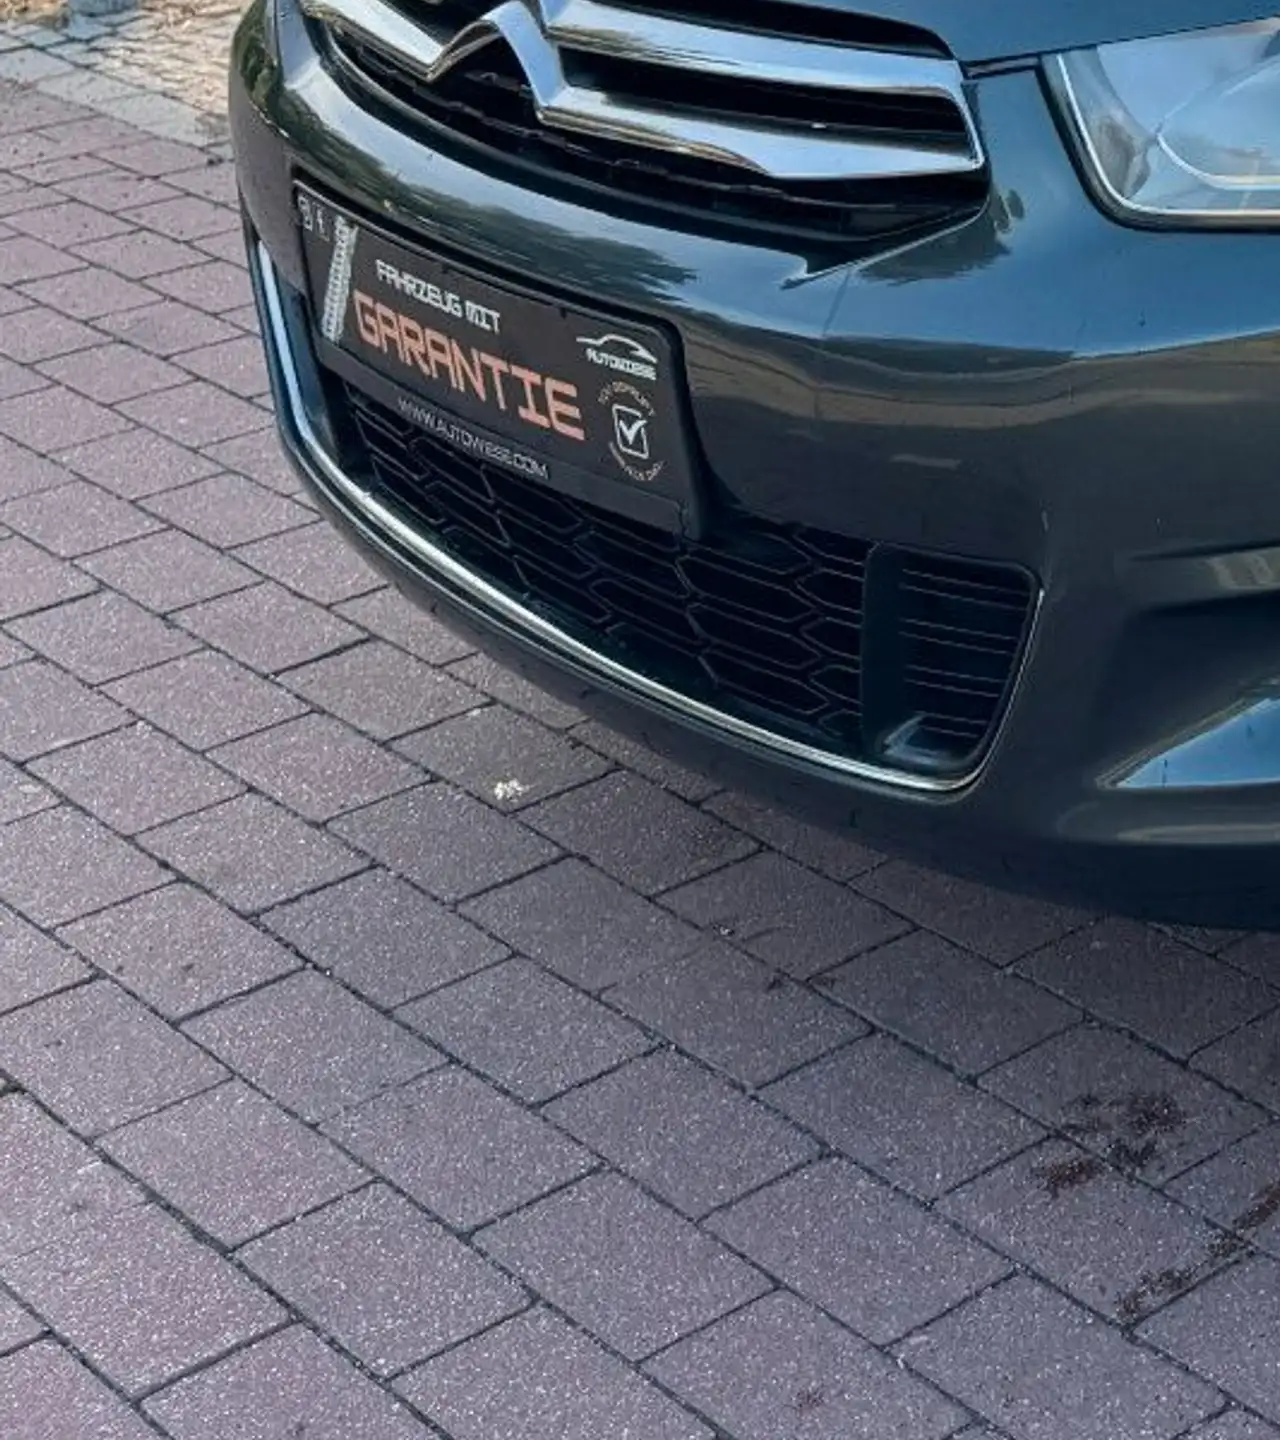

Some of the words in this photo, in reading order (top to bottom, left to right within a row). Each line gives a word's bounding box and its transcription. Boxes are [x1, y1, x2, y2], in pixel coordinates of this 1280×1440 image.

[375, 259, 463, 319] FAHRZEUG
[464, 299, 501, 335] MIT
[353, 288, 585, 442] GARANTIE
